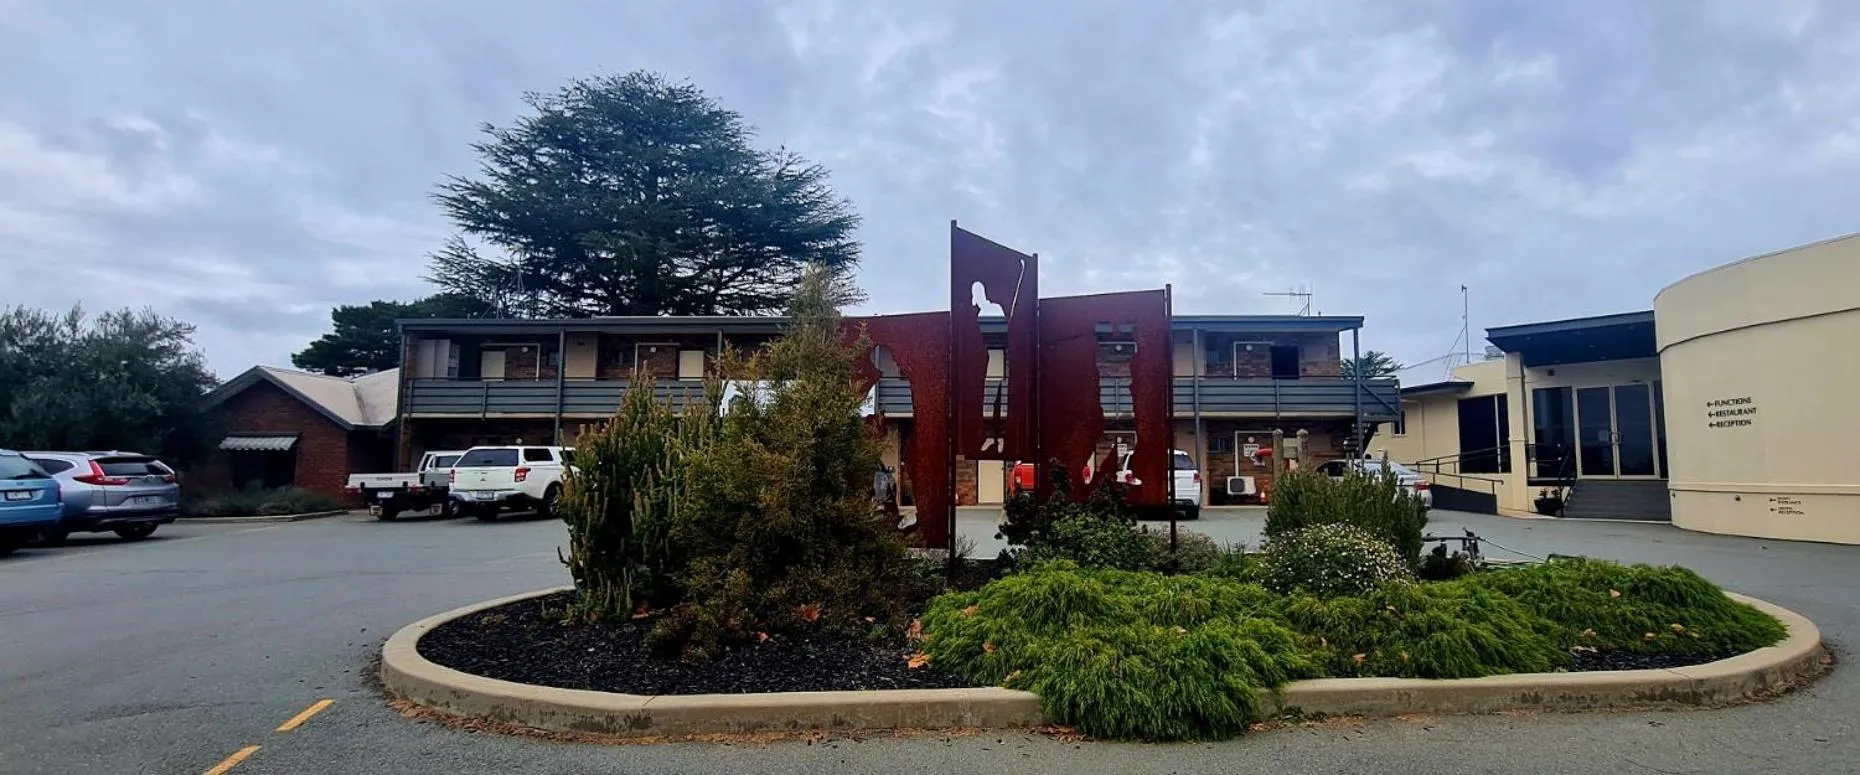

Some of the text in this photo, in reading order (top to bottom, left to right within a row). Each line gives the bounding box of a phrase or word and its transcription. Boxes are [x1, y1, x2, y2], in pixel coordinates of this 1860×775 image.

[1714, 397, 1752, 407] FUNCTIONS
[1715, 407, 1757, 417] RESTAURANT
[1716, 419, 1752, 428] RECEPTION
